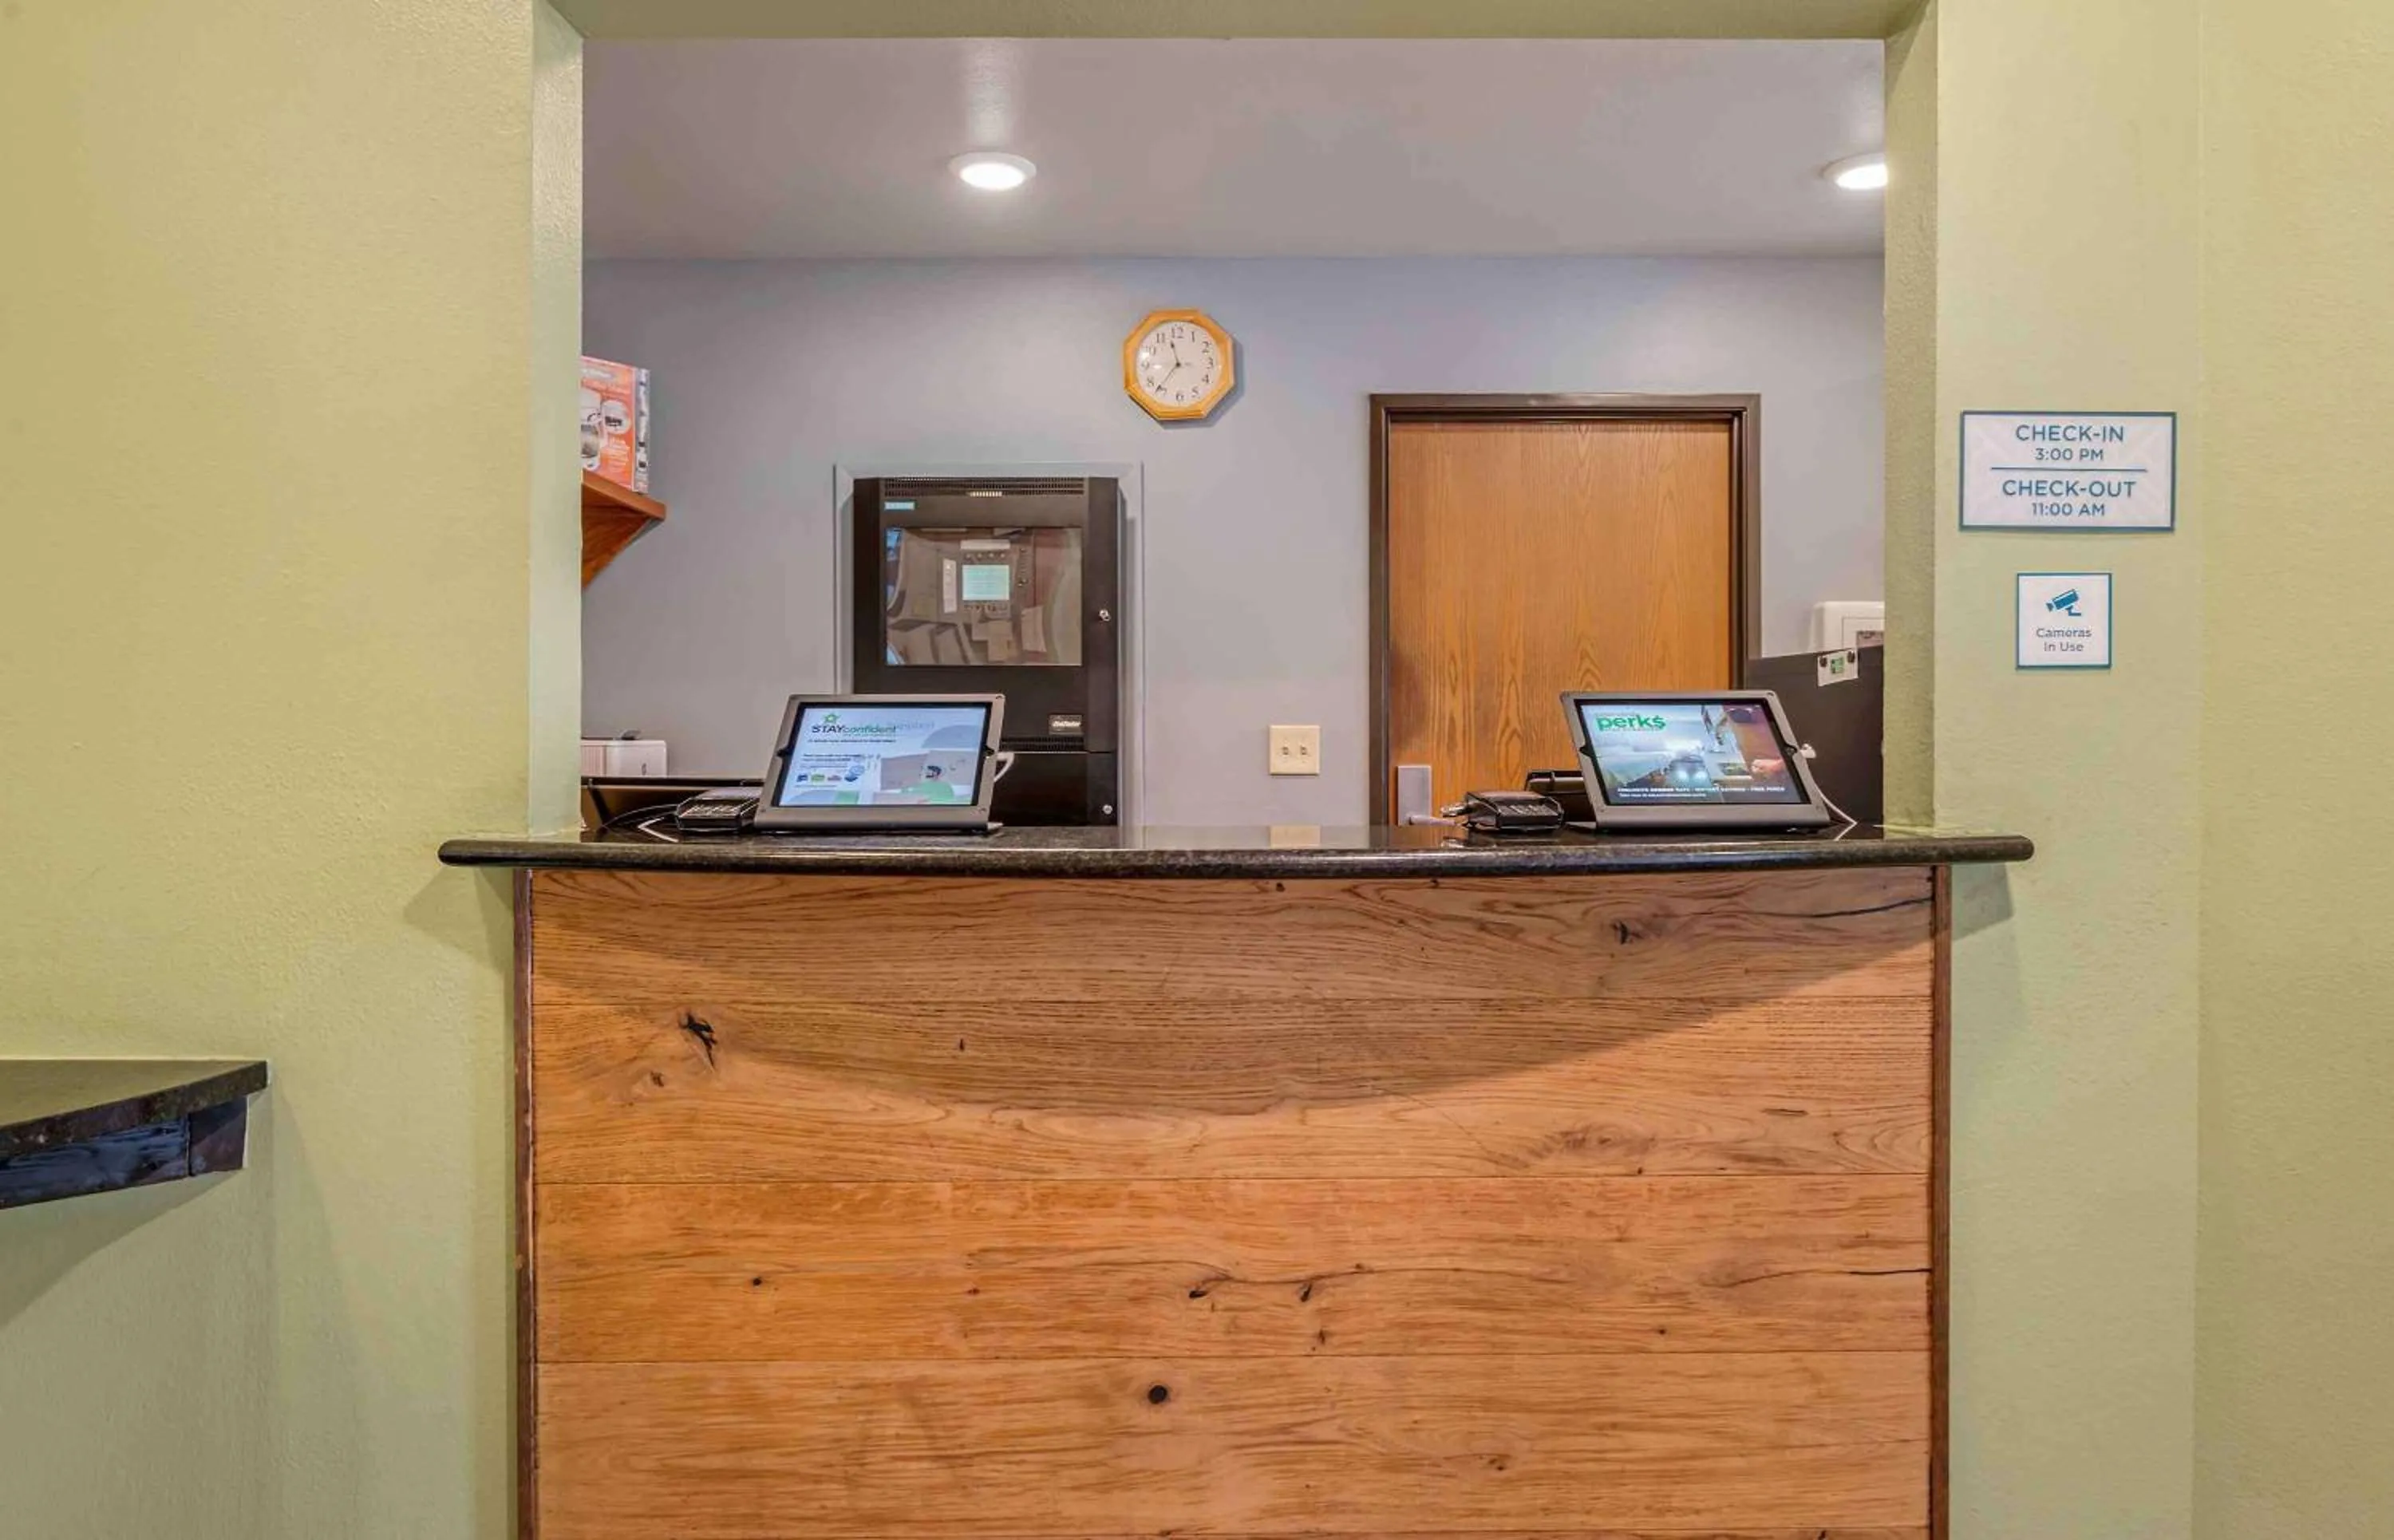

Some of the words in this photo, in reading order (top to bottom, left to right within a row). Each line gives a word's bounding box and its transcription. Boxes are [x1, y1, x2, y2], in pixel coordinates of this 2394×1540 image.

[1156, 332, 1166, 344] 11
[1171, 326, 1184, 339] 12
[1191, 330, 1195, 343] 1
[1201, 341, 1211, 353] 2
[1207, 357, 1214, 369] 3
[1147, 376, 1156, 387] 8
[1201, 374, 1210, 385] 4
[1175, 390, 1184, 402] 6
[1191, 385, 1199, 398] 5
[2015, 424, 2124, 442] CHECK-IN
[2034, 448, 2073, 461] 3:00
[2079, 448, 2104, 461] PM
[2002, 479, 2137, 498] CHECK-OUT
[2032, 502, 2073, 516] 11:00
[2079, 503, 2105, 516] AM
[2036, 628, 2092, 638] Cameras
[2044, 642, 2056, 652] In
[2060, 642, 2084, 652] Use
